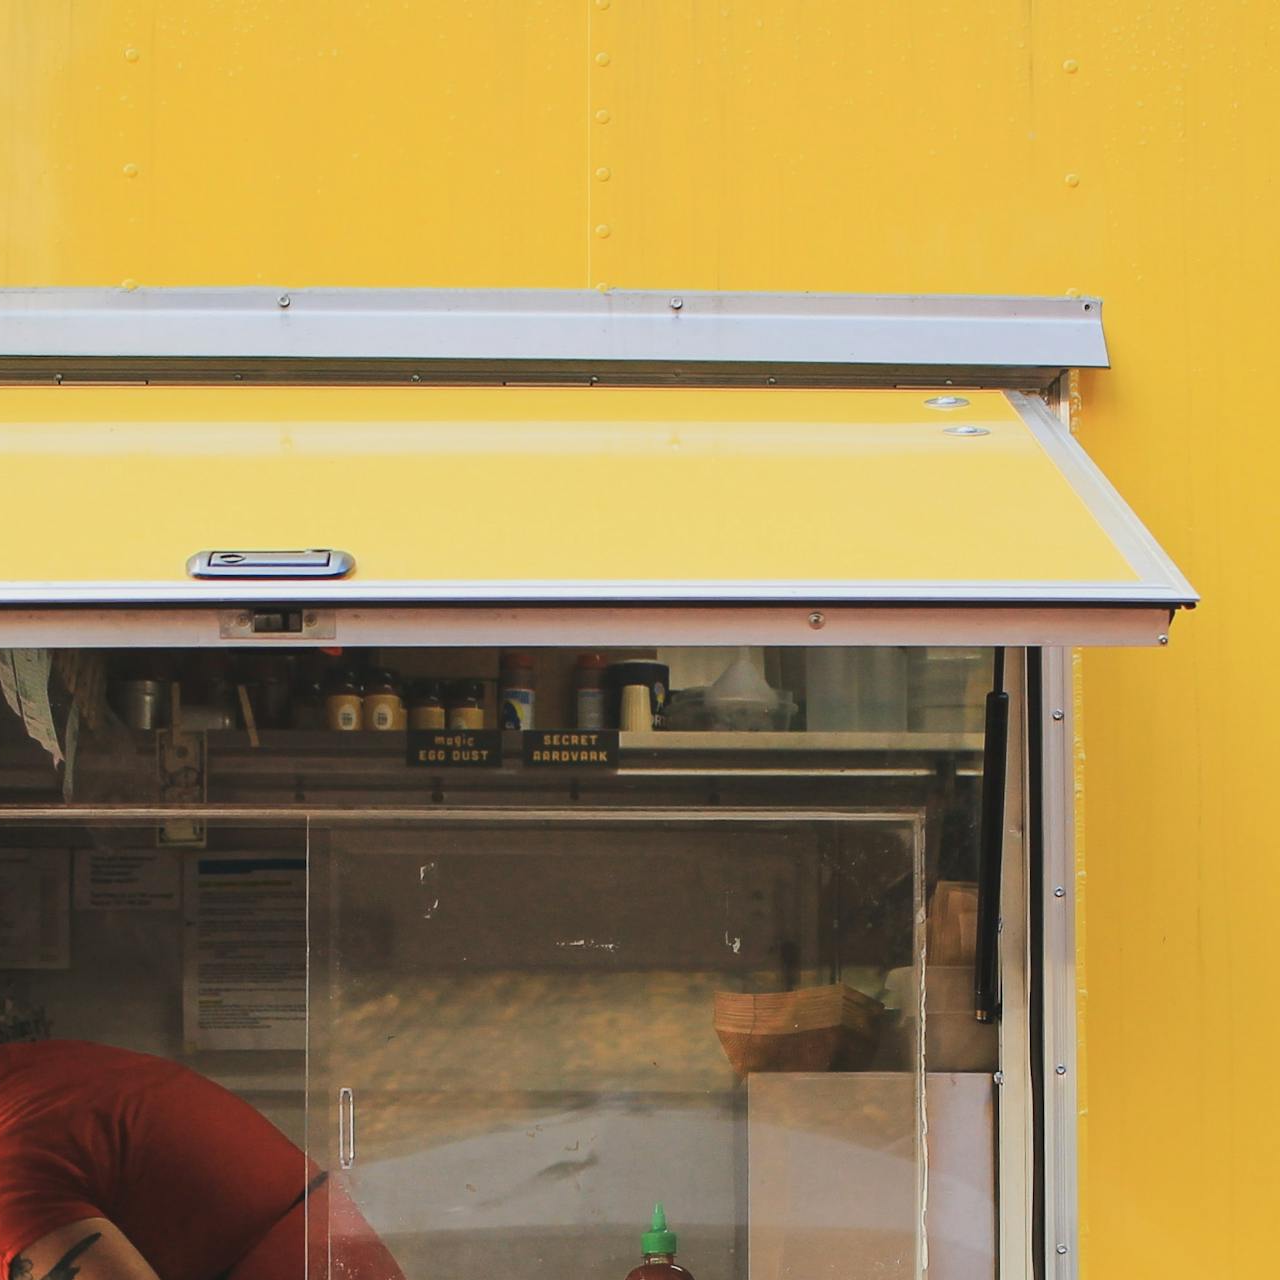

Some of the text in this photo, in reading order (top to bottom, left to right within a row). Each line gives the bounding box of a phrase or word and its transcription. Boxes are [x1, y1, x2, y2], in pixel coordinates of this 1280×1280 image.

[434, 734, 475, 747] magic
[543, 734, 599, 746] SECRET
[419, 750, 489, 761] EGG DUST
[532, 751, 609, 762] AARDVARK
